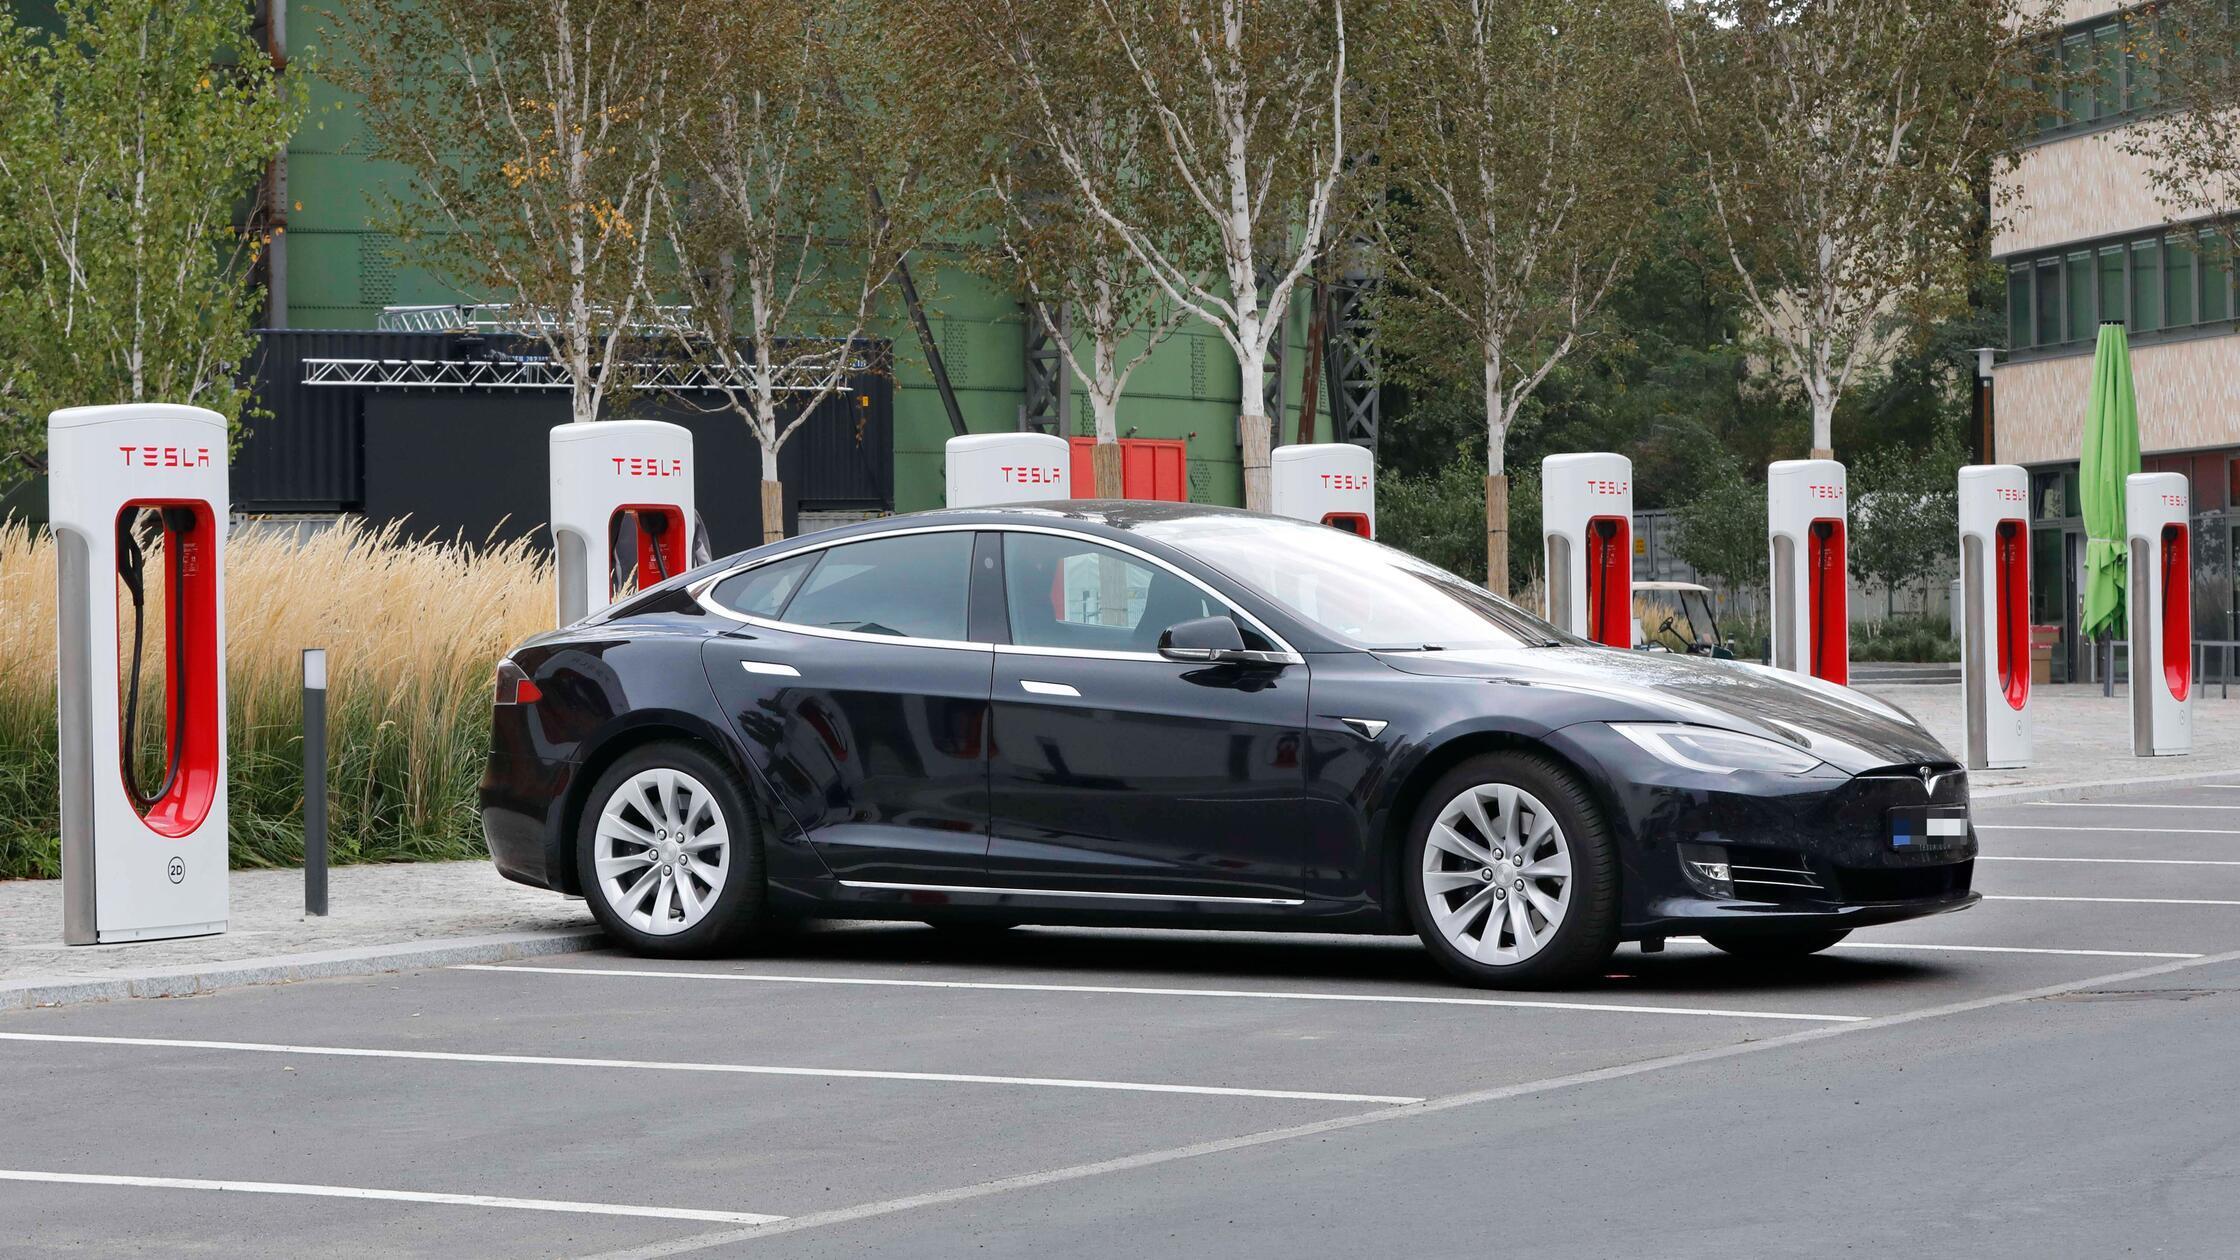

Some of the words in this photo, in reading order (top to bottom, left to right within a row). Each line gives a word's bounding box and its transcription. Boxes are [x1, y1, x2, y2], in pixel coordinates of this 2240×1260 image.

[119, 447, 209, 467] TESLA
[612, 457, 681, 477] TESLA
[1001, 466, 1061, 484] TESLA
[1320, 474, 1368, 490] TESLA
[1587, 480, 1628, 494] TESLA
[1809, 485, 1843, 498] TESLA
[1996, 488, 2026, 501] TESLA
[170, 865, 183, 876] 2D
